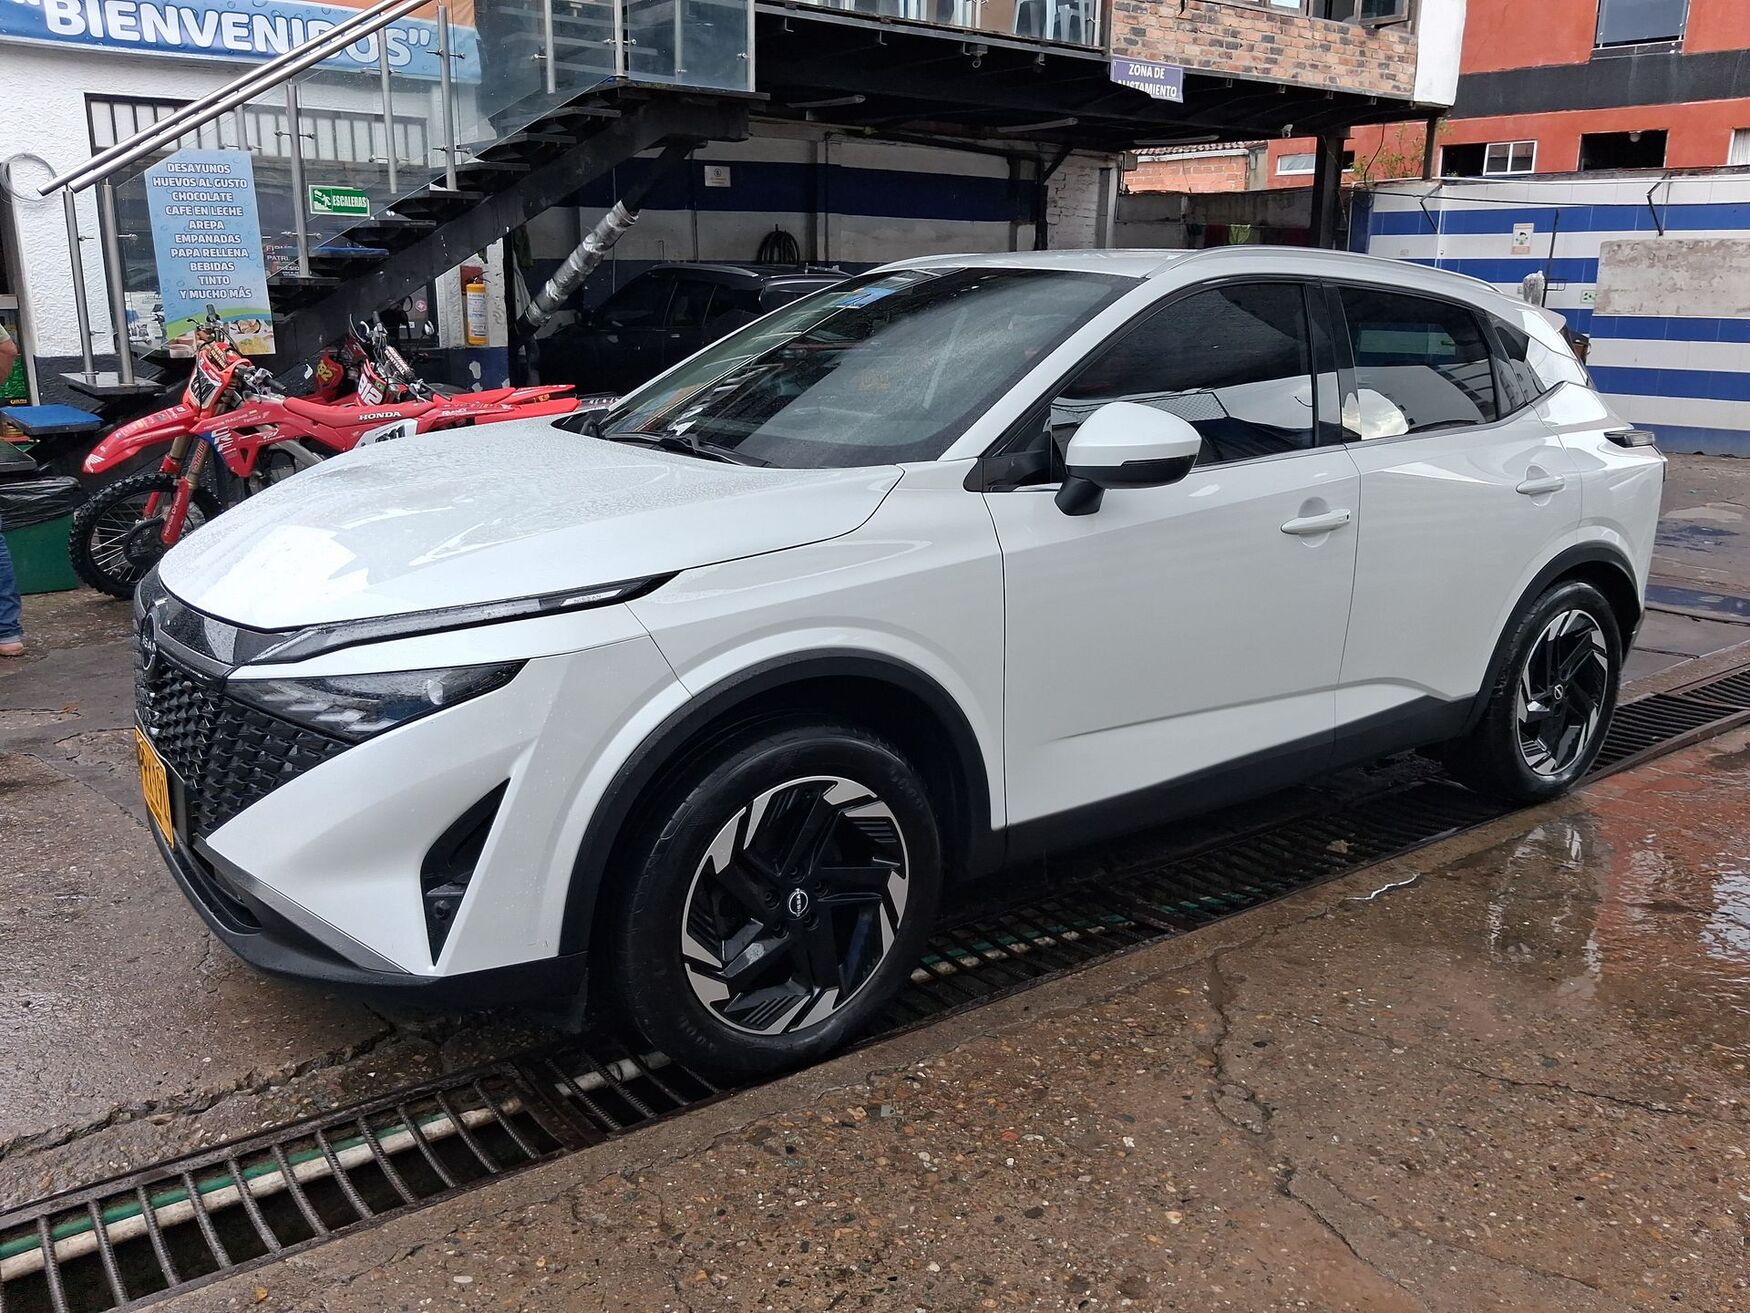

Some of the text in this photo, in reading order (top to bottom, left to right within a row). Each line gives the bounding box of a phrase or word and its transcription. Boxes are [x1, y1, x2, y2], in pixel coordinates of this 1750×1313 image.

[13, 0, 431, 66] BIENVENIDOS"
[1128, 64, 1166, 79] ZONA DE
[1117, 80, 1177, 97] TAMIENTO
[167, 163, 231, 174] DESAYUNOS
[153, 177, 248, 188] HUEVOS AL GUSTO
[172, 191, 233, 202] CHOCOLATE
[332, 195, 367, 208] ESCALERAS
[165, 206, 243, 216] CAFE EN LECHE
[189, 220, 225, 230] AREPA
[175, 234, 241, 244] EMPANADAS
[170, 248, 249, 258] PAPA RELLENA
[190, 262, 235, 272] BEBIDAS
[198, 275, 230, 285] TINTO
[180, 287, 252, 299] Y MUCHO MÁS
[359, 411, 402, 421] HONDA
